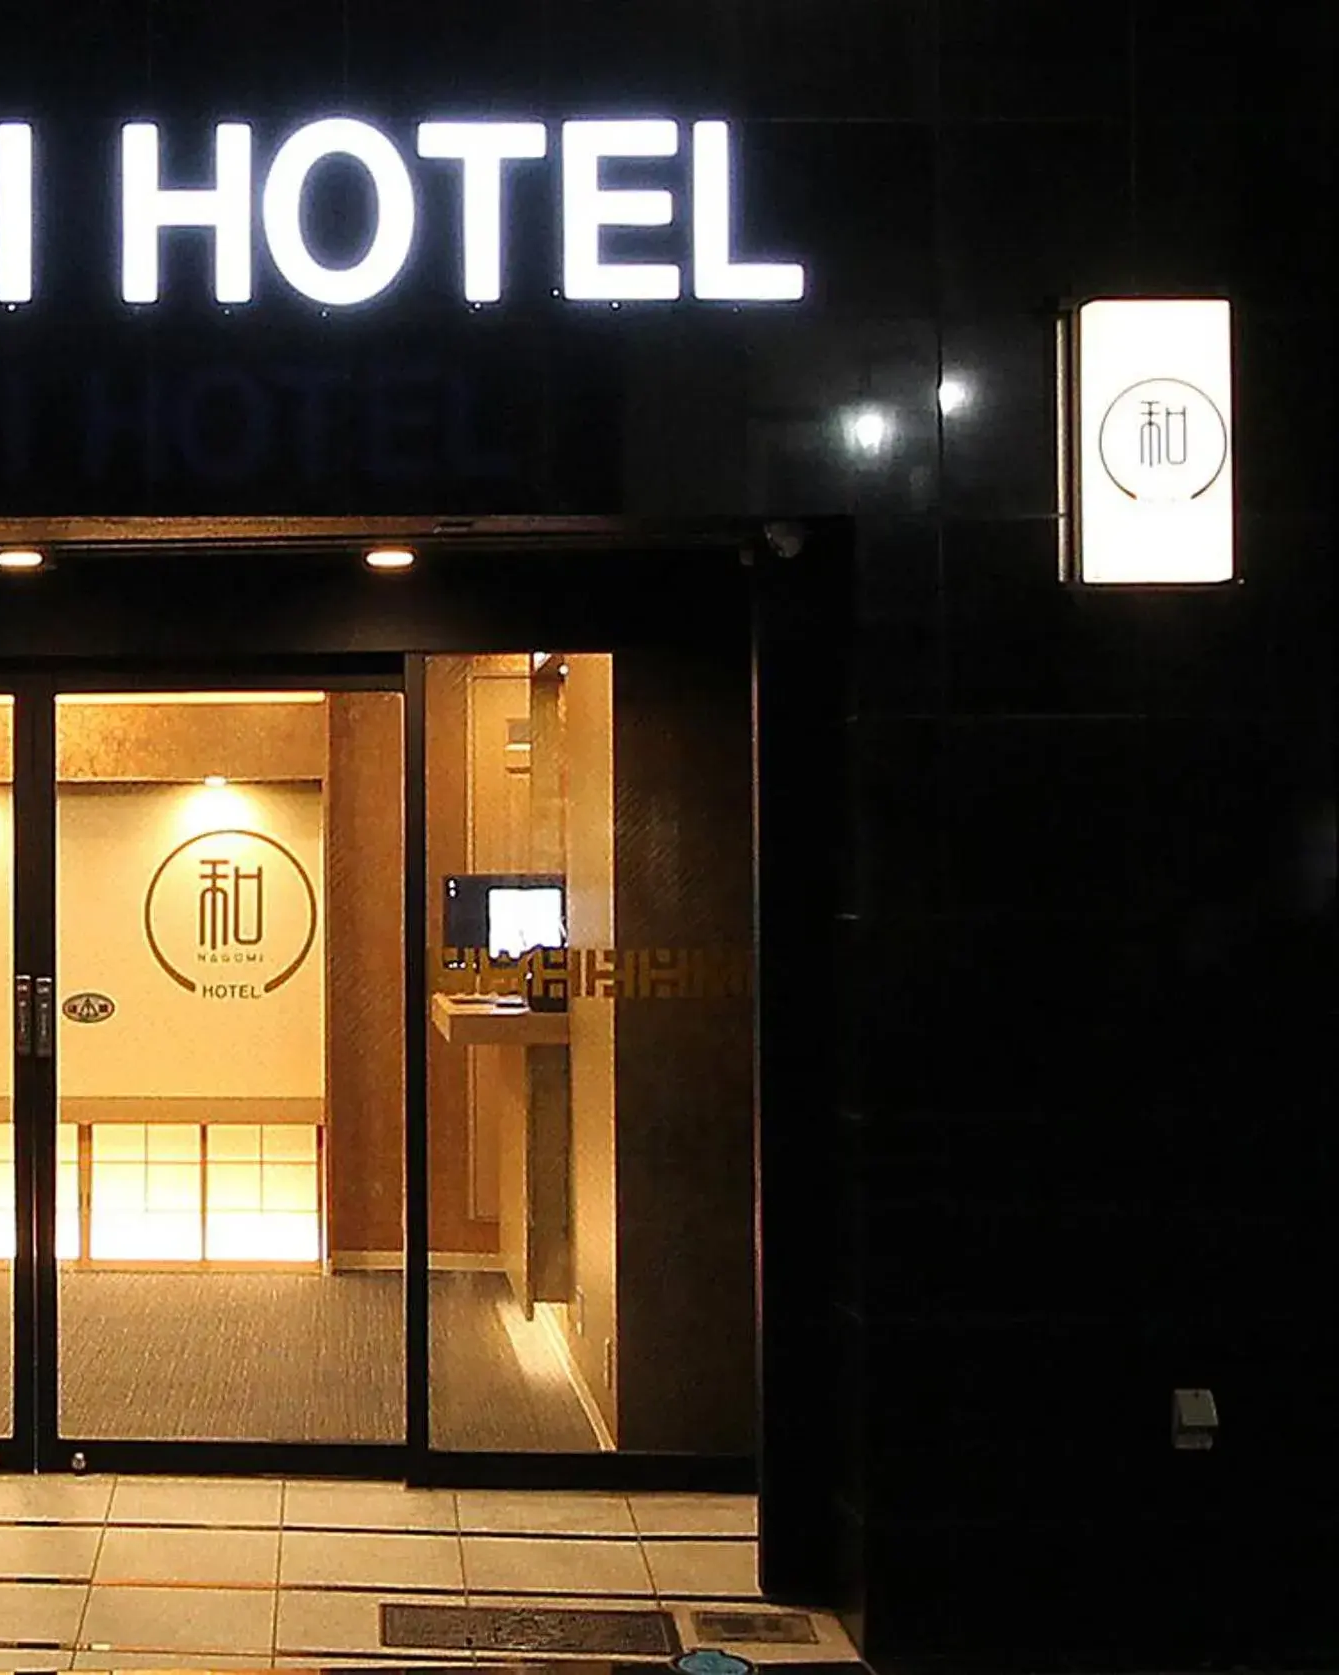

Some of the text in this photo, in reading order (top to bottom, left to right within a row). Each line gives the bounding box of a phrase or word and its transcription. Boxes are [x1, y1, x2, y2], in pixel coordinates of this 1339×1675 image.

[122, 118, 805, 307] HOTEL
[198, 859, 264, 950] 和
[202, 984, 261, 999] HOTEL
